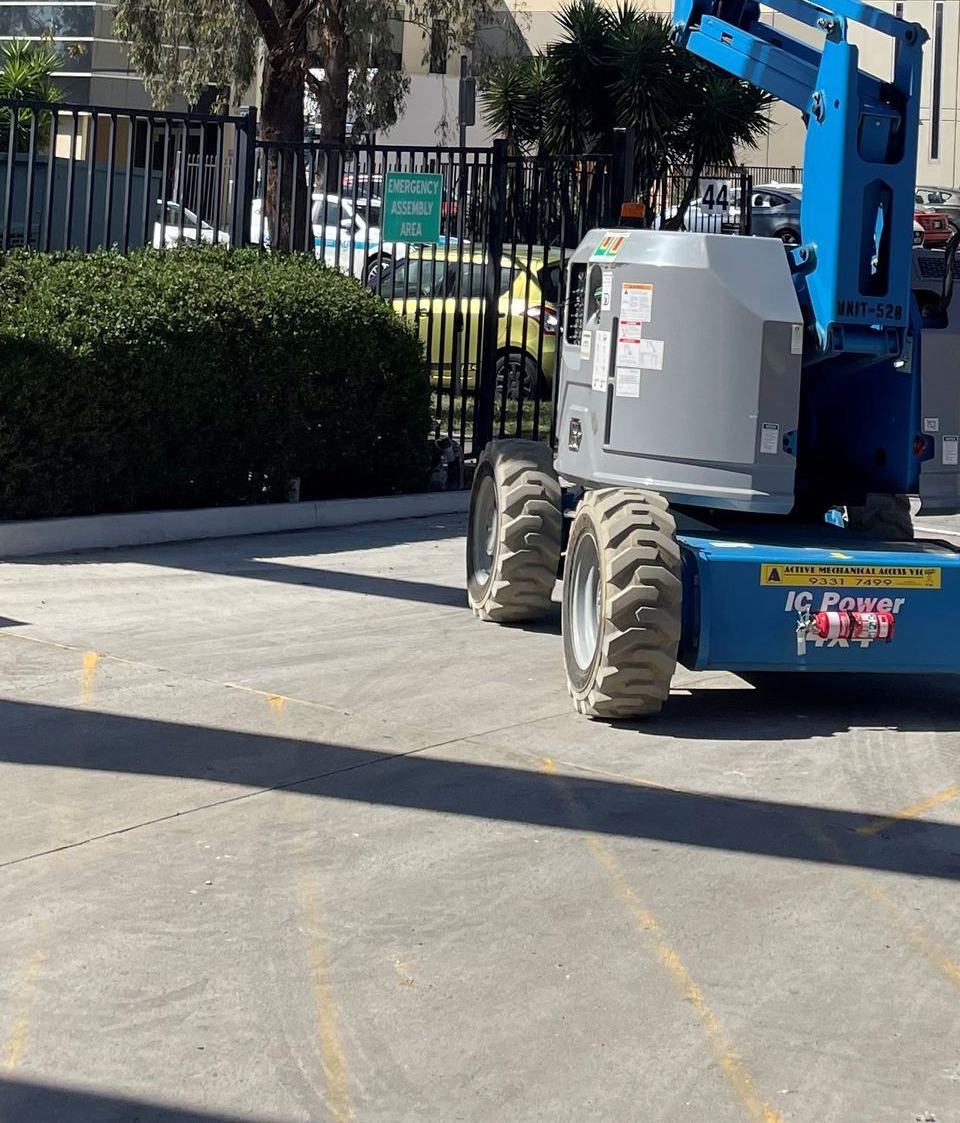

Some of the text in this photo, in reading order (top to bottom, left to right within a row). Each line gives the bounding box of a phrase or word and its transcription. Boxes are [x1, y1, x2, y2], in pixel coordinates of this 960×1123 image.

[388, 178, 439, 195] EMERGENCY
[702, 184, 729, 210] 44
[391, 200, 434, 215] ASSEMBLY
[400, 222, 422, 236] AREA
[838, 300, 903, 320] UNIT-528
[784, 566, 816, 574] ACTIVE
[818, 566, 876, 575] MECHANICAL
[878, 568, 907, 576] ACCESS
[809, 577, 845, 585] 9331
[855, 578, 893, 586] 7499
[785, 591, 905, 614] IC Power
